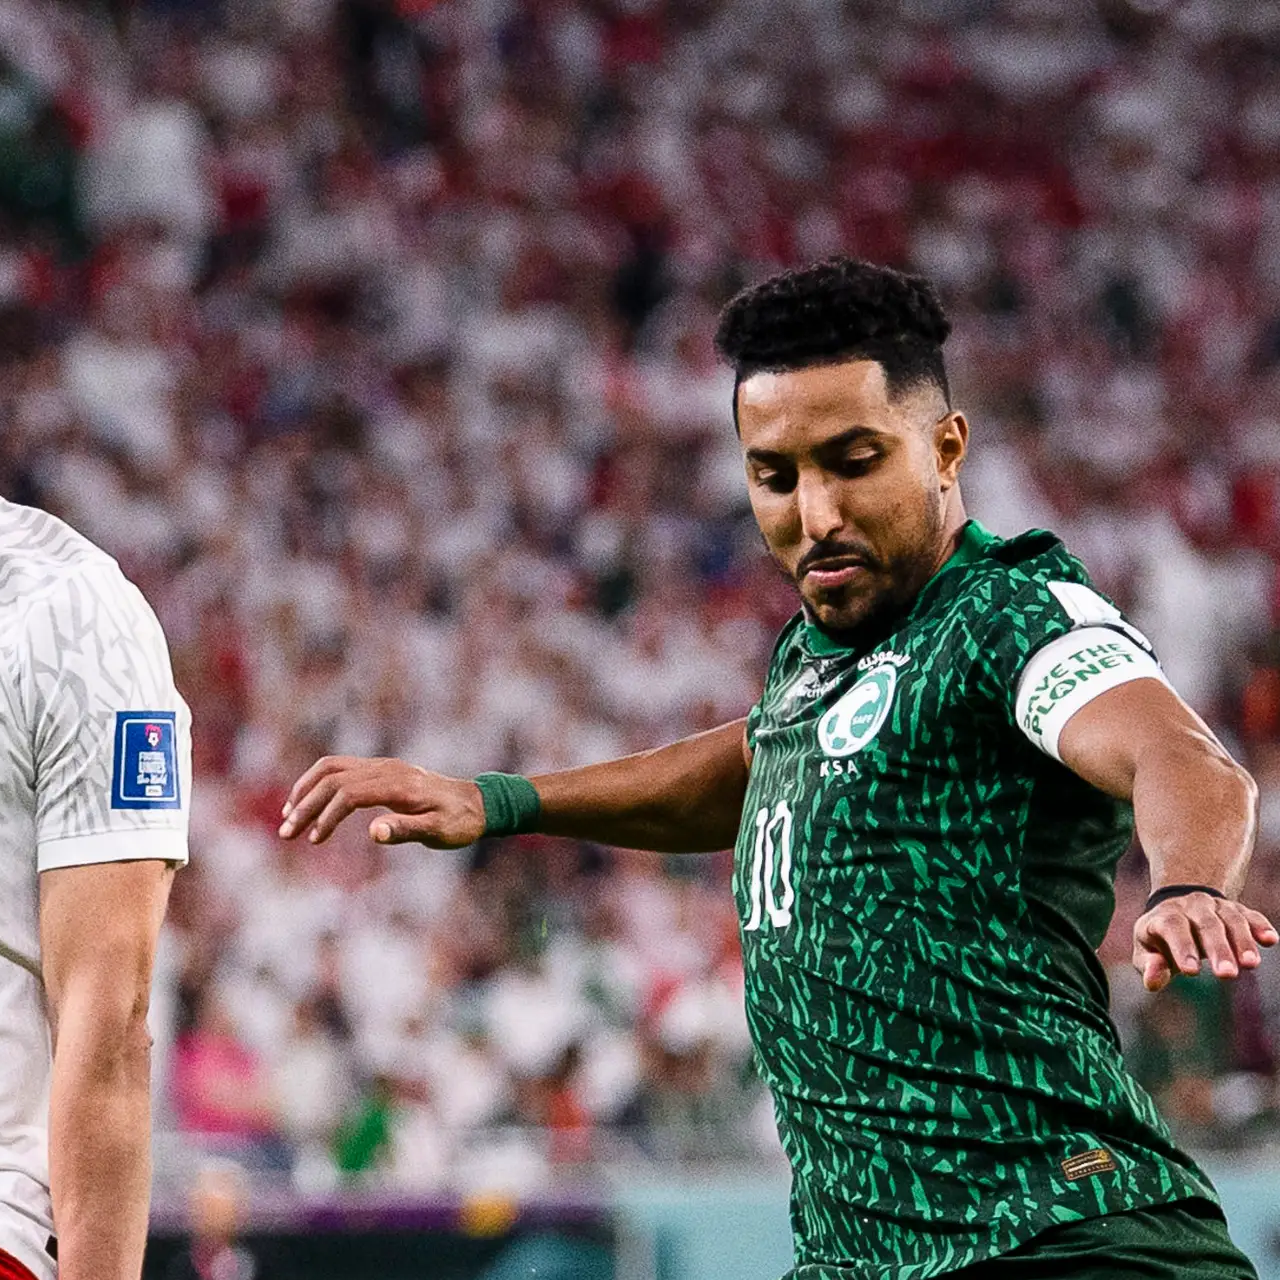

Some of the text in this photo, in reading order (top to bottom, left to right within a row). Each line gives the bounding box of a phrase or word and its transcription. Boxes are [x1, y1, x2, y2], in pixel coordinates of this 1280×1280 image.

[1068, 643, 1128, 663] THE
[1032, 653, 1135, 736] PLANET
[820, 760, 859, 777] KSA
[743, 800, 794, 931] 10
